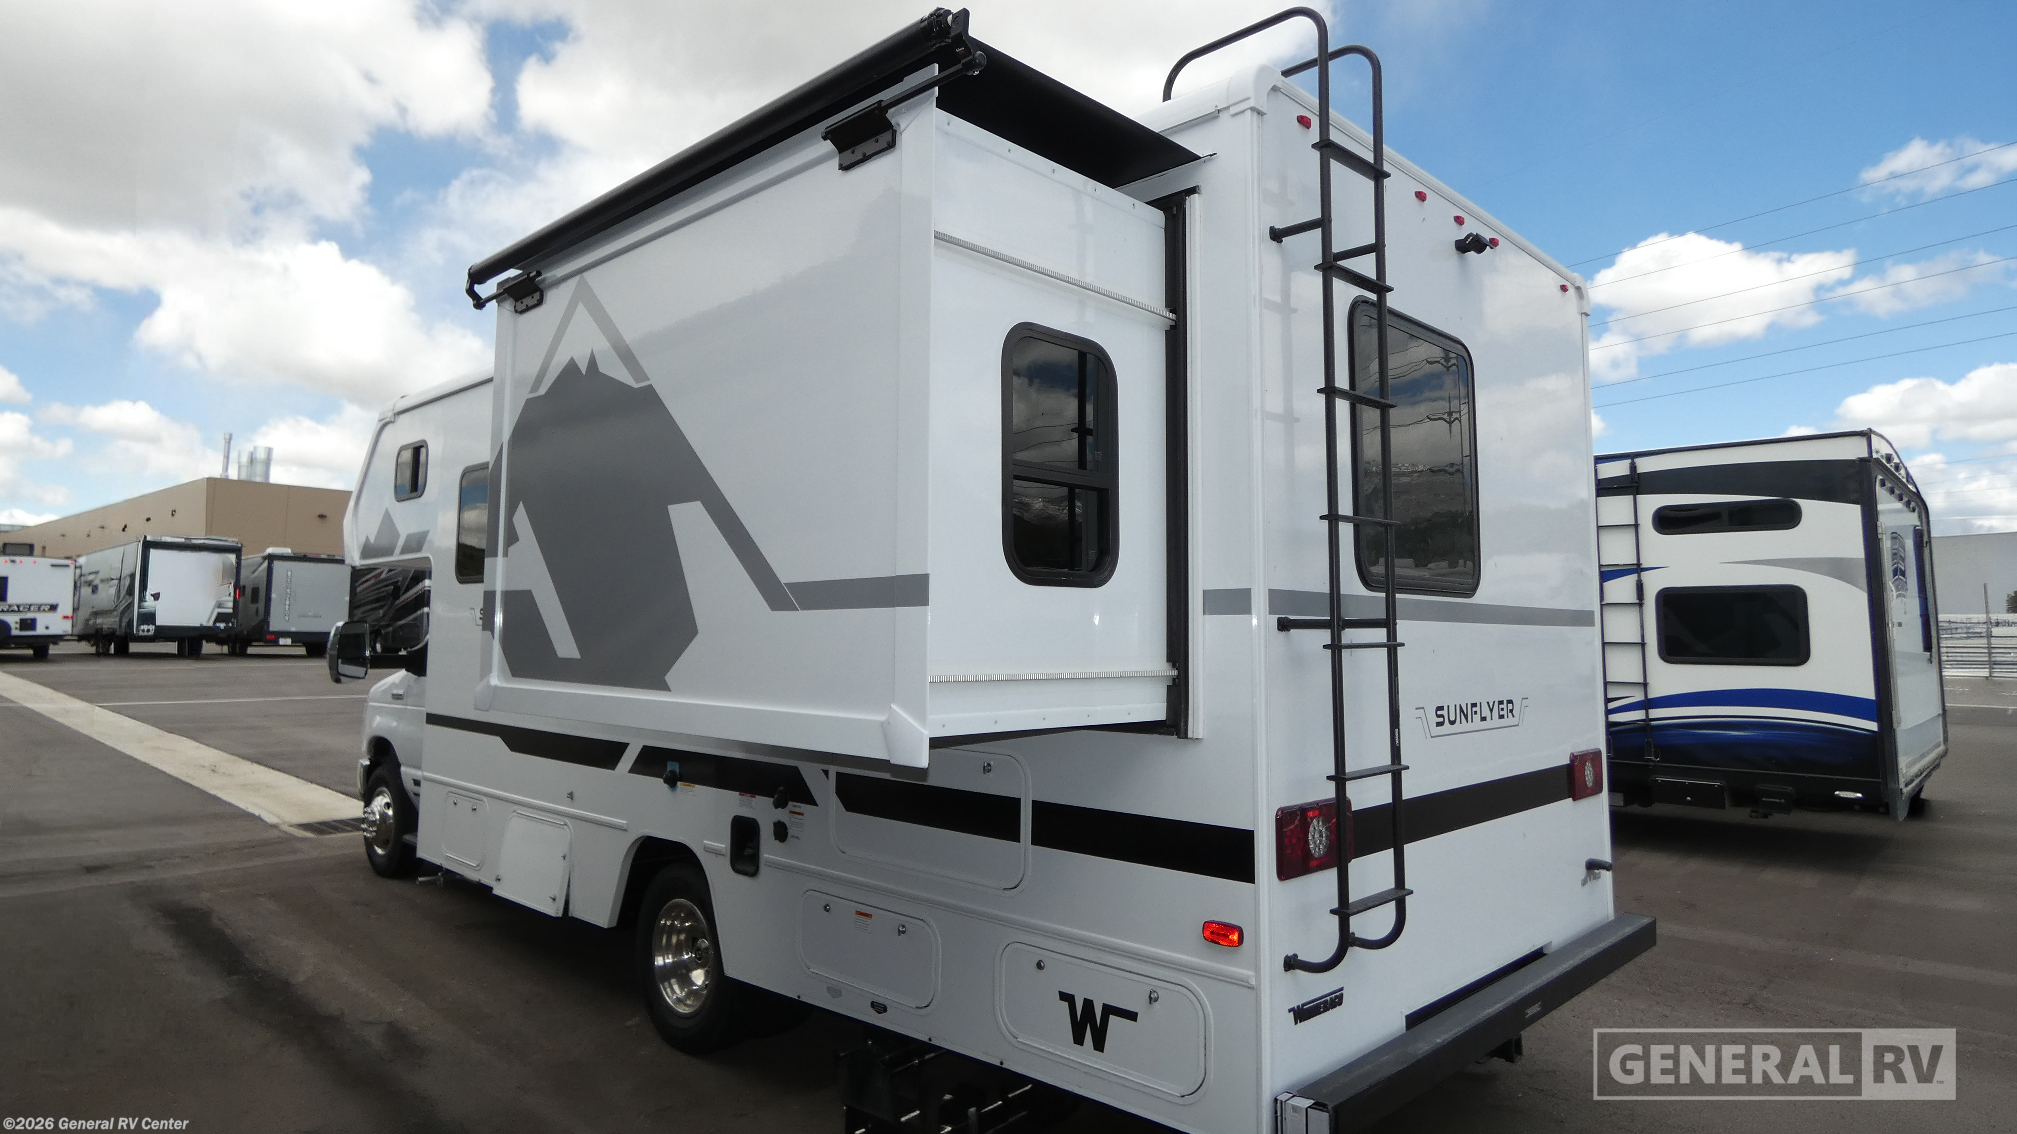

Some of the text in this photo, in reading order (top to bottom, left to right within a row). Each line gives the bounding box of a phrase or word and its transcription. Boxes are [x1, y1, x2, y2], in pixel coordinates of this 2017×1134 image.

[1434, 699, 1515, 728] SUNFLYER
[1058, 991, 1138, 1053] W
[1288, 986, 1345, 1026] WEBAGO
